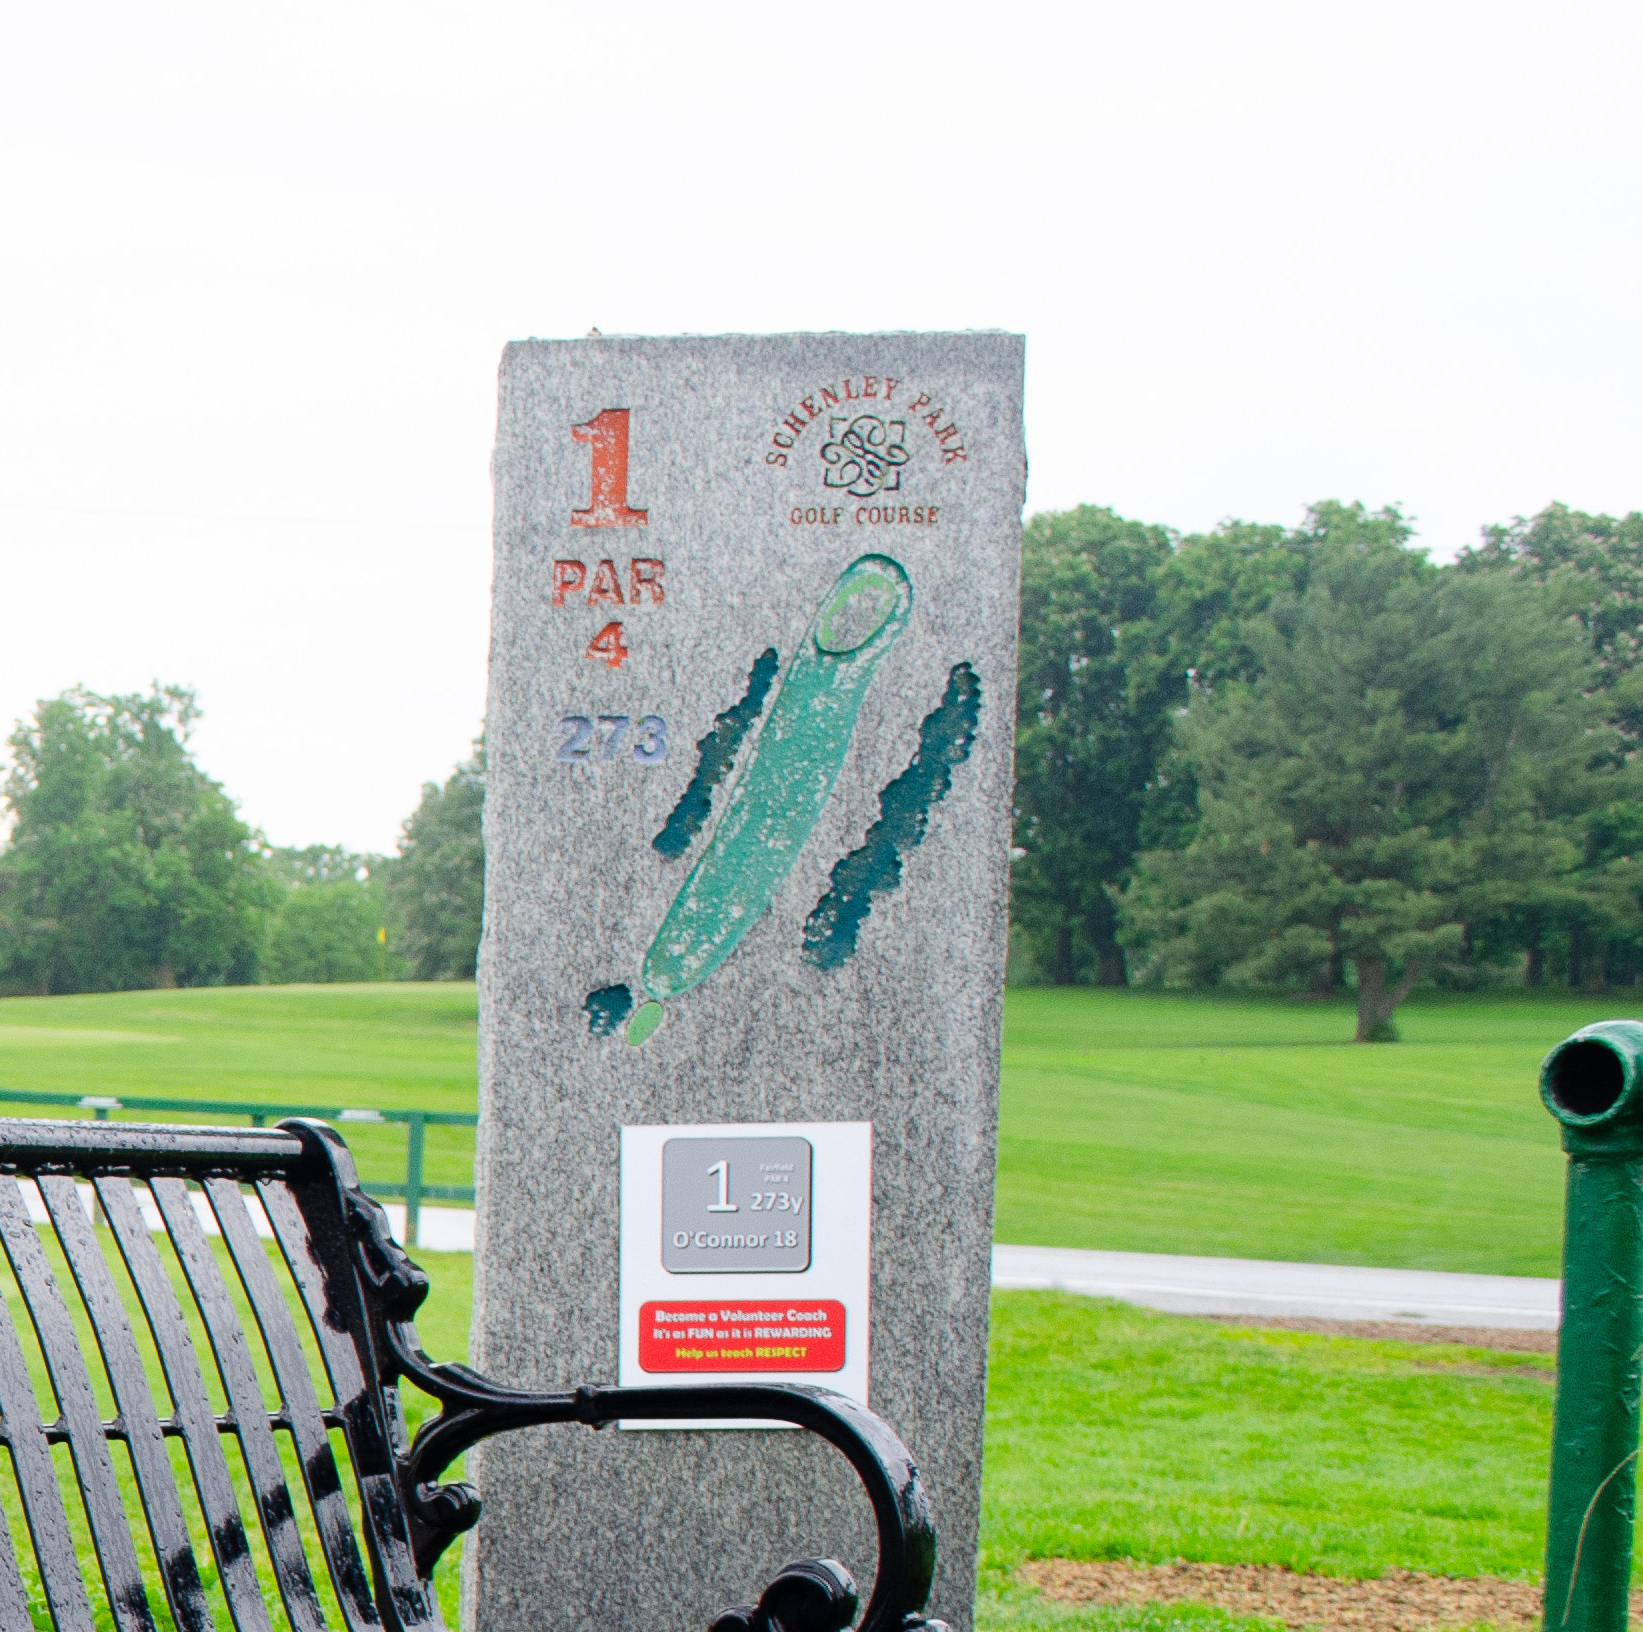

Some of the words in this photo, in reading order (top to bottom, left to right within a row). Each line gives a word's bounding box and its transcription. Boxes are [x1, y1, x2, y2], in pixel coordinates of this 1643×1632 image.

[765, 375, 902, 468] SCHENLEY
[909, 391, 967, 465] PARK
[571, 408, 648, 527] 1
[790, 507, 844, 525] GOLF
[856, 506, 941, 525] COURSE
[552, 558, 666, 606] PAR
[585, 621, 628, 668] 4
[557, 715, 667, 764] 273
[706, 1160, 739, 1212] 1
[750, 1192, 803, 1215] 273y
[673, 1231, 768, 1249] O'Connor
[774, 1230, 798, 1248] 18
[653, 1328, 670, 1339] It's
[672, 1330, 686, 1339] as
[687, 1328, 714, 1339] FUN
[716, 1330, 729, 1339] as
[731, 1328, 741, 1339] it
[743, 1328, 752, 1339] is
[754, 1327, 832, 1338] REWARDING
[655, 1310, 706, 1322] Become
[708, 1312, 718, 1321] a
[719, 1310, 784, 1321] Volunteer
[786, 1309, 827, 1321] Coach
[675, 1347, 704, 1359] Help
[755, 1346, 807, 1358] RESPECT
